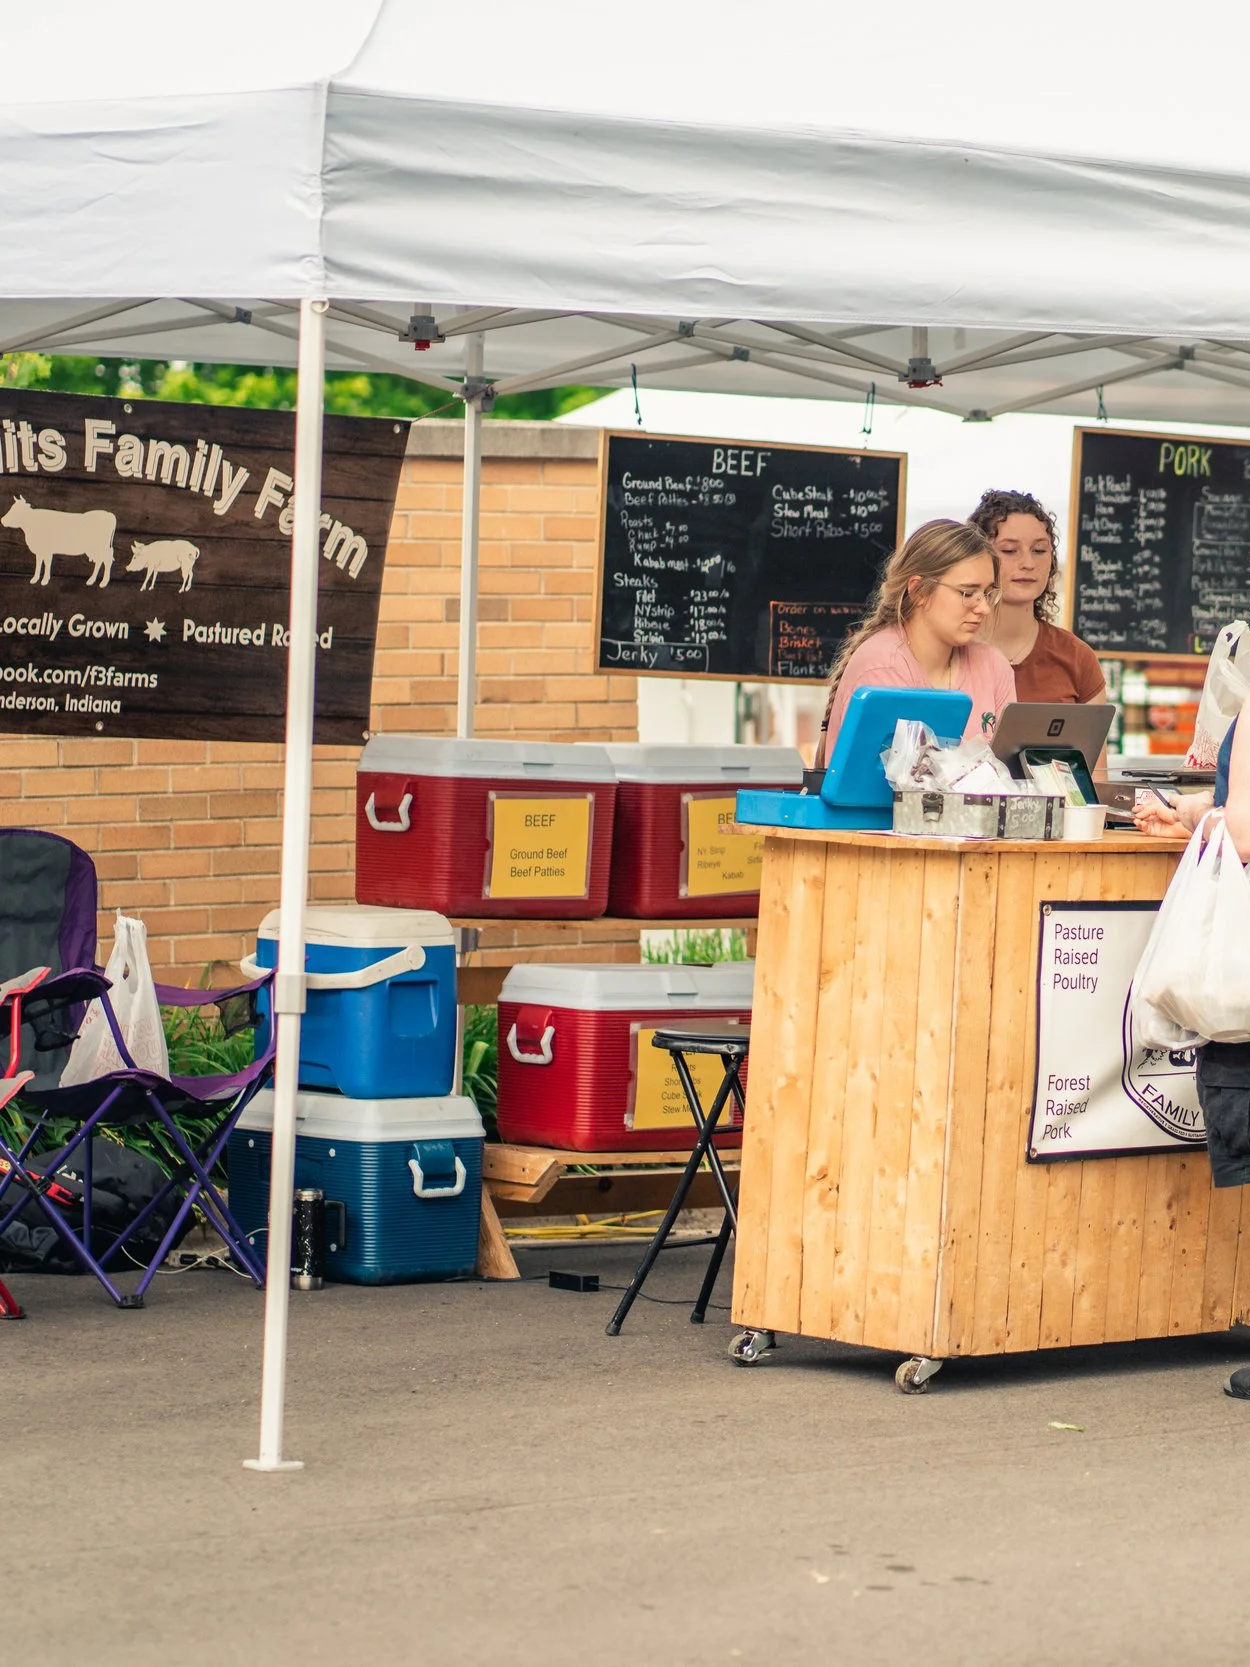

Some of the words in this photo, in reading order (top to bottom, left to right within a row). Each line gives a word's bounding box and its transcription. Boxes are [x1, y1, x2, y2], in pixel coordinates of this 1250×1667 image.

[0, 418, 67, 473] its
[84, 417, 250, 516] Family
[711, 448, 772, 477] BEEF
[1158, 441, 1213, 479] PORK
[622, 471, 663, 491] Ground
[772, 484, 804, 501] Cube
[620, 509, 653, 529] Roasts
[770, 517, 812, 538] Short
[613, 571, 659, 588] Steaks
[0, 612, 64, 641] ocally
[68, 613, 129, 640] Grown
[183, 618, 266, 647] Pastured
[271, 623, 333, 650] Raed
[779, 635, 823, 648] Brisket
[606, 642, 658, 669] Jerky
[777, 660, 816, 676] Flank
[65, 692, 122, 714] Indiana
[1010, 797, 1042, 813] Jerky
[524, 813, 557, 827] BEEF
[717, 812, 737, 825] BE
[509, 848, 544, 860] Ground
[546, 847, 569, 859] Beef
[510, 866, 532, 878] Beef
[534, 865, 566, 877] Patties
[1054, 923, 1104, 941] Pasture
[1053, 948, 1099, 966] Raised
[1052, 973, 1099, 993] Poultry
[1047, 1074, 1091, 1091] Forest
[1045, 1098, 1090, 1116] Raised
[1141, 1083, 1200, 1127] FAMILY
[1042, 1122, 1072, 1140] Pork
